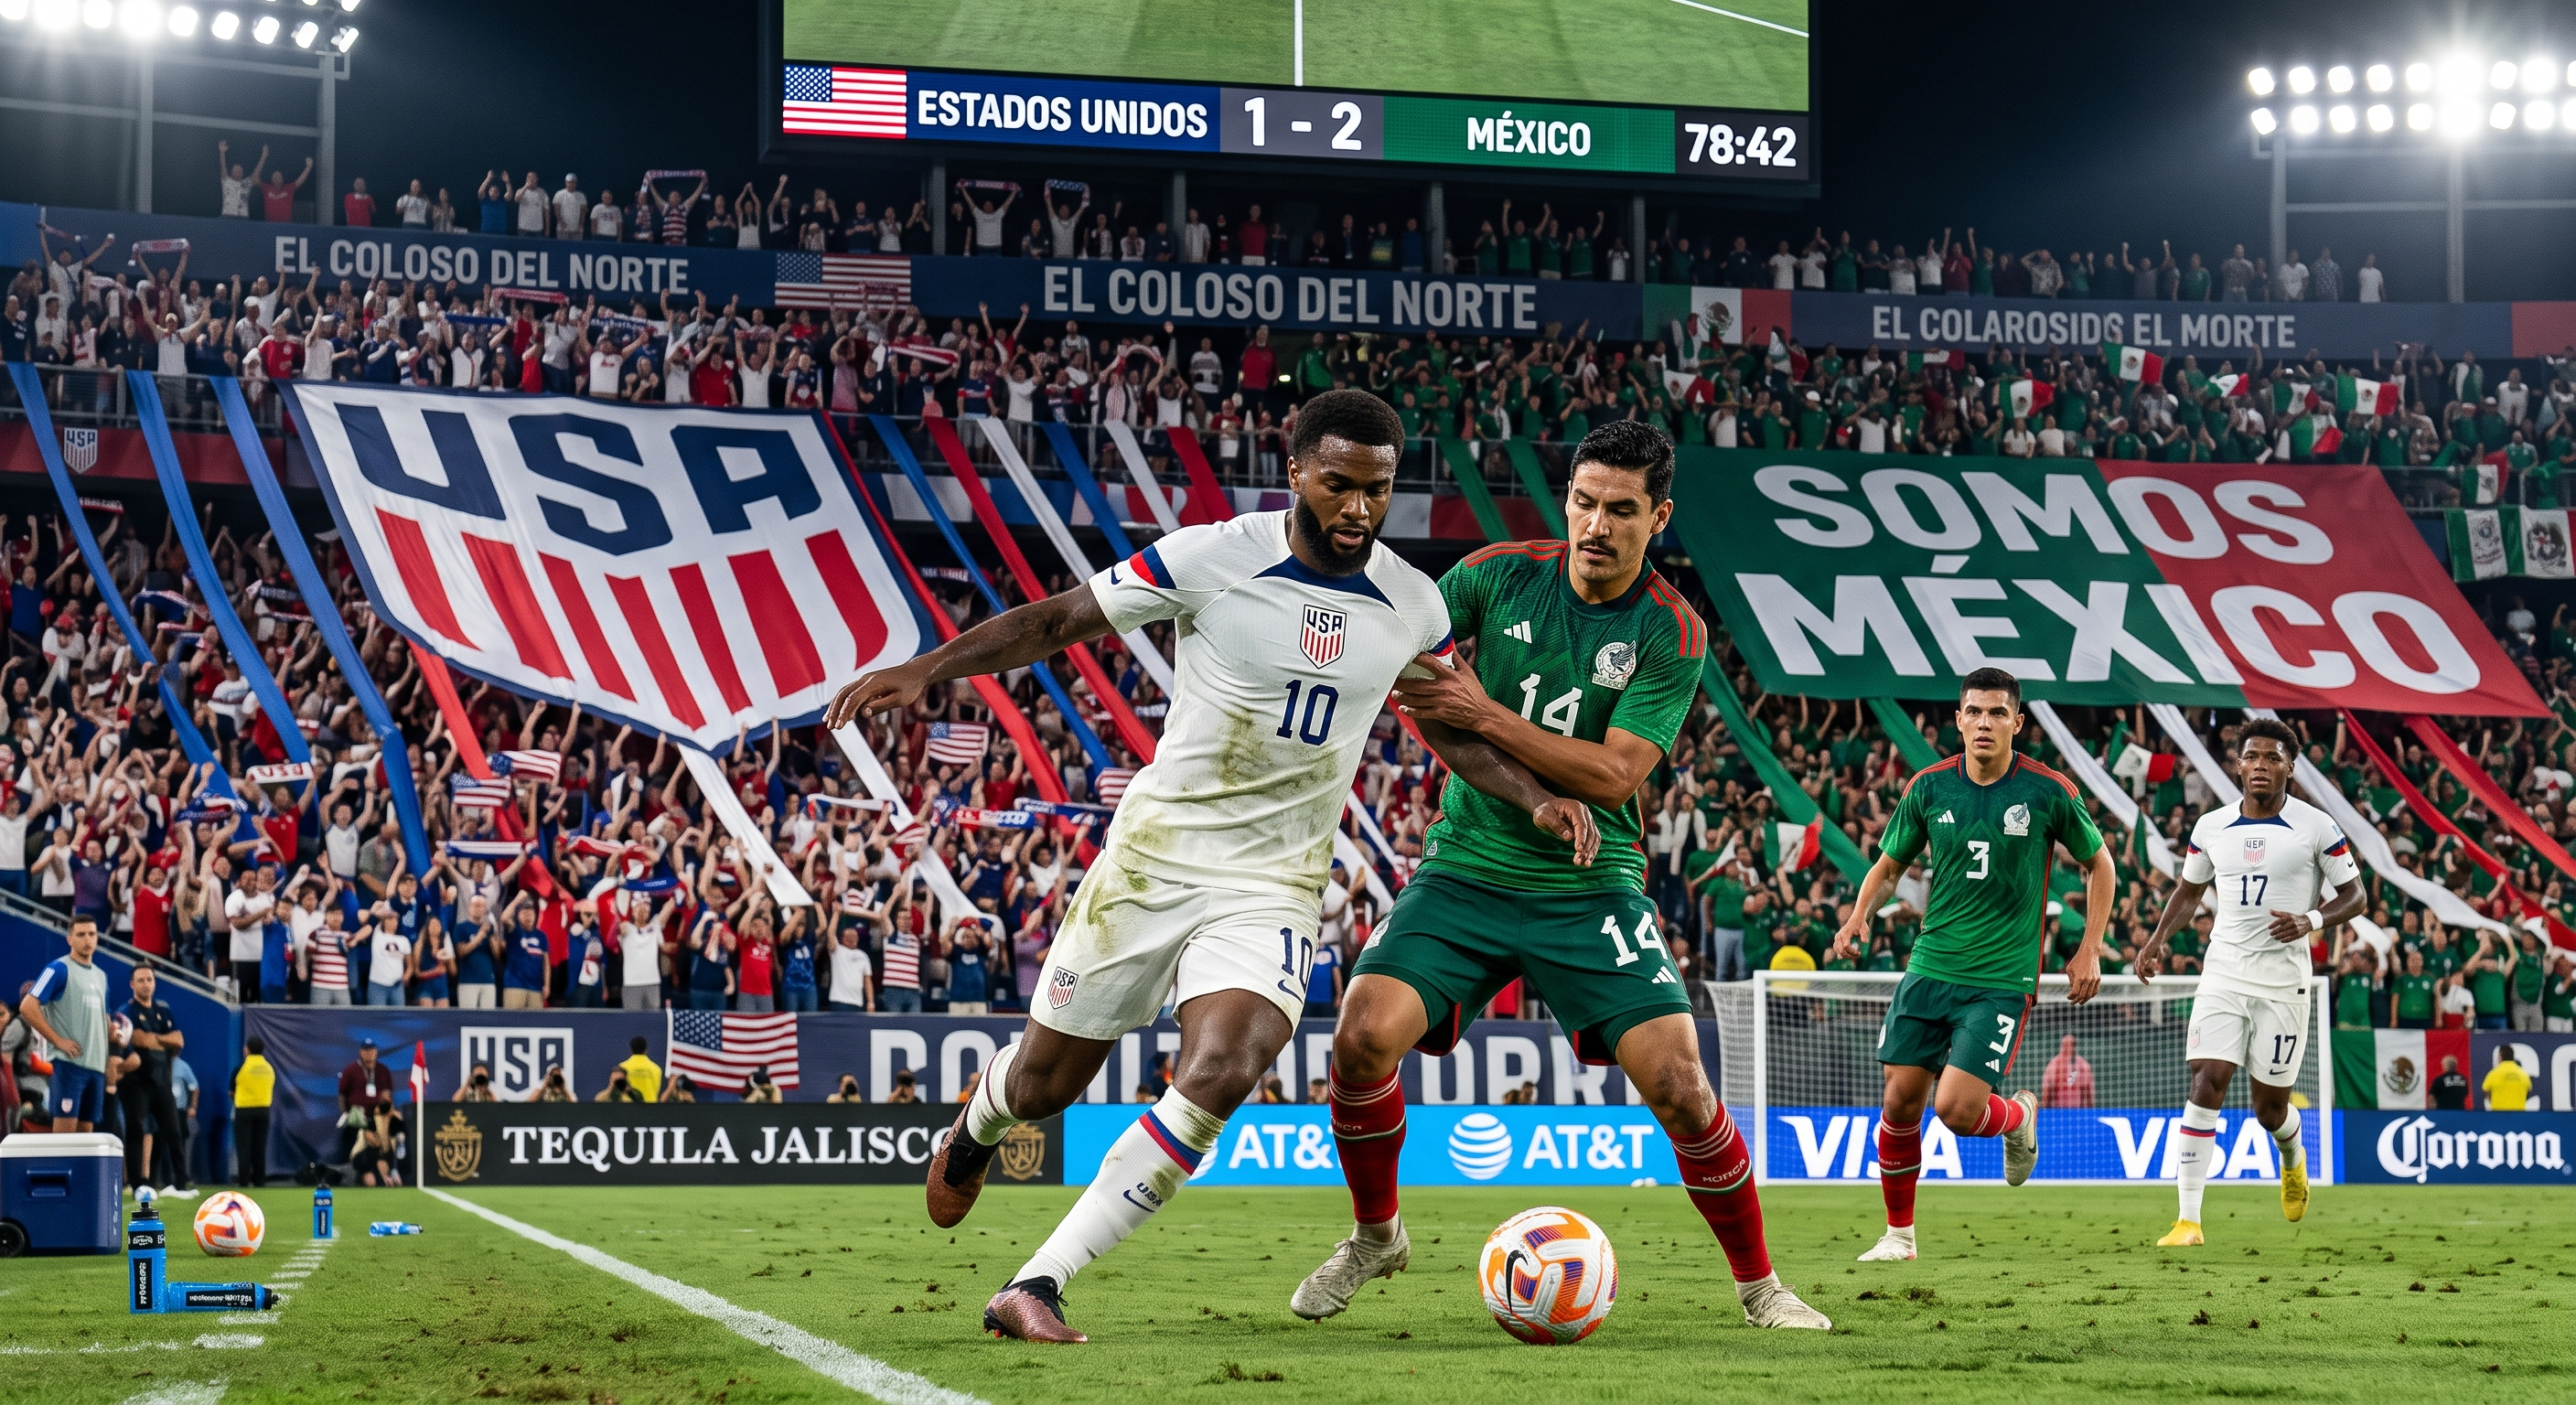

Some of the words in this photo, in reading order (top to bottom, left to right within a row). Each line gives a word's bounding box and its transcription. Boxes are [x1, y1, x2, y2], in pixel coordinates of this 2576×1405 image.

[918, 90, 1071, 132] ESTADOS
[1080, 98, 1208, 138] UNIDOS
[1244, 97, 1265, 146] 1
[1331, 102, 1363, 151] 2
[1466, 110, 1592, 156] MÉXICO
[1684, 123, 1798, 167] 78:42
[275, 236, 319, 275] EL
[329, 240, 479, 284] COLOSO
[491, 250, 560, 288] DEL
[570, 253, 689, 295] NORTE
[1045, 266, 1096, 313] EL
[1108, 269, 1283, 320] COLOSO
[1299, 277, 1380, 324] DEL
[1393, 280, 1538, 329] NORTE
[1873, 306, 1910, 339] EL
[2133, 313, 2173, 347] EL
[2181, 314, 2297, 348] MORTE
[66, 430, 96, 447] USA
[333, 402, 823, 556] USA
[1754, 466, 2334, 565] SOMOS
[1305, 608, 1343, 634] USA
[1734, 555, 2482, 694] MÉXICO
[1277, 679, 1339, 746] 10
[1519, 672, 1583, 737] 14
[1966, 840, 1990, 880] 3
[2240, 874, 2269, 906] 17
[1280, 927, 1313, 994] 10
[1600, 910, 1669, 968] 14
[1989, 1014, 2016, 1056] 3
[2271, 1034, 2298, 1065] 17
[469, 1035, 565, 1093] USA
[501, 1126, 739, 1173] TEQUILA
[1228, 1123, 1343, 1170] AT&
[1522, 1124, 1652, 1170] AT&T
[2377, 1115, 2566, 1184] Corona
